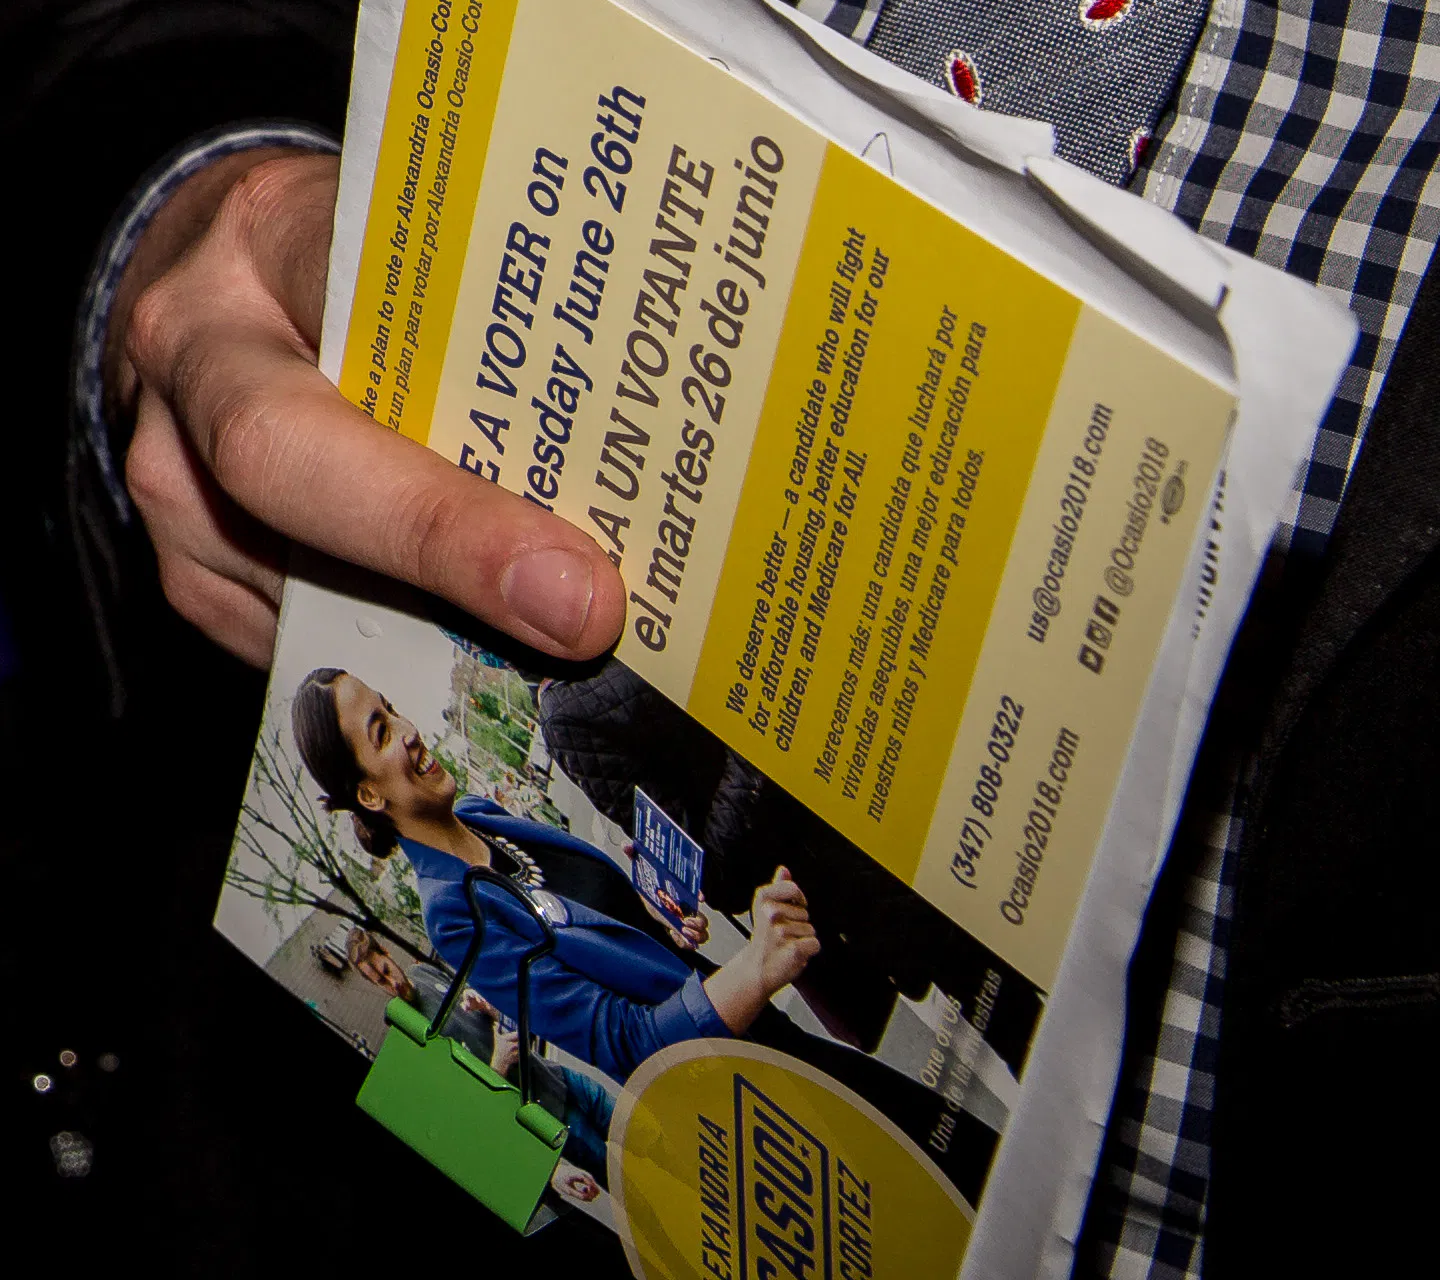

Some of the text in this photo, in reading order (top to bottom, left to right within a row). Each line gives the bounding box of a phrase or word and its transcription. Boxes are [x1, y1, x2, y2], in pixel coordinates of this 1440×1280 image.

[395, 112, 431, 224] Alexandria
[425, 108, 461, 217] Alexandria
[525, 146, 569, 217] on
[388, 218, 410, 254] for
[421, 210, 440, 253] por
[834, 226, 866, 284] fight
[383, 253, 403, 297] vote
[411, 245, 433, 299] votar
[521, 84, 647, 519] esday June 26th
[614, 142, 715, 409] VOTANTE
[827, 279, 852, 325] will
[376, 299, 395, 323] to
[402, 299, 423, 350] para
[474, 220, 552, 399] VOTER
[367, 369, 382, 386] a
[369, 322, 391, 373] plan
[392, 345, 414, 395] plan
[814, 327, 840, 376] who
[358, 385, 379, 420] ke
[388, 390, 406, 418] un
[633, 134, 785, 653] el martes 26 de junio
[467, 407, 511, 457] A
[593, 405, 651, 502] UN
[787, 377, 827, 487] candidate
[746, 245, 890, 737] for affordable housing, better education for our
[783, 487, 800, 506] a
[1024, 401, 1114, 644] us@ocasio2018.com
[1102, 435, 1170, 598] @Ocasio2018
[754, 529, 788, 599] better
[812, 303, 958, 785] Merecemos más: una candidata que luchará por
[839, 320, 987, 801] viviendas asequibles, una mejor educación para
[772, 448, 868, 753] children, and Medicare for All.
[734, 597, 771, 681] deserve
[865, 448, 985, 824] nuestros niños y Medicare para todos.
[724, 681, 749, 715] We
[948, 694, 1025, 890] (347) 808-0322
[998, 726, 1080, 926] Ocasio2018.com
[920, 1047, 946, 1089] One
[929, 1110, 957, 1154] Una
[697, 1113, 732, 1280] EXANDRIA
